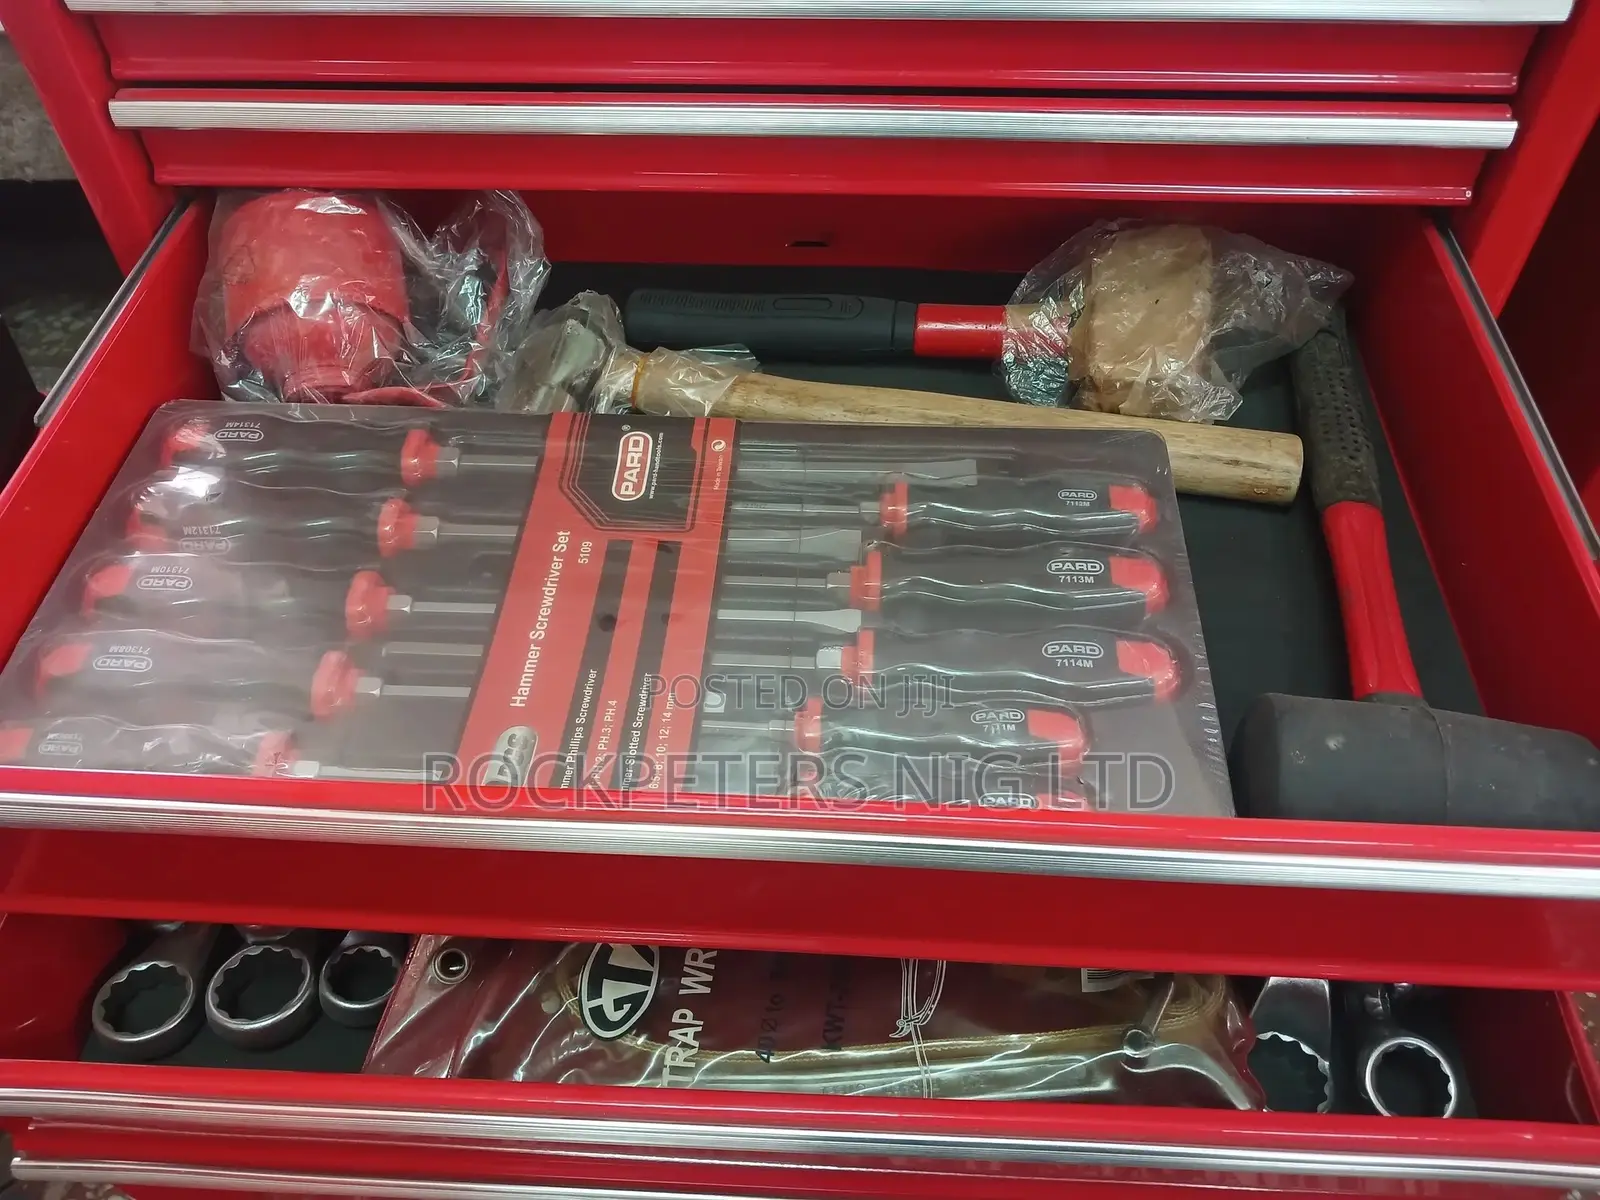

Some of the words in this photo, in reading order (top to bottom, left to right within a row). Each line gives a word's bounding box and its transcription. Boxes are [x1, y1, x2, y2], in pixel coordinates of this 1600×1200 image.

[216, 430, 260, 439] PARD
[620, 435, 645, 495] PARD
[649, 432, 664, 500] www.pard-handtools.com
[1060, 490, 1096, 499] PARD
[578, 541, 593, 564] 5109
[1050, 562, 1101, 572] PARD
[140, 578, 189, 588] PARD
[1059, 575, 1095, 584] 7113M
[510, 644, 541, 707] Hammer
[529, 556, 564, 640] Screwdriver
[552, 530, 571, 552] Set
[1046, 644, 1100, 655] PARD
[96, 658, 149, 669] PARD
[1055, 658, 1094, 668] 7114M
[632, 672, 652, 728] Screwdriver
[665, 692, 676, 710] mm
[566, 726, 584, 764] Phillips
[575, 668, 598, 724] Screwdriver
[603, 699, 618, 723] PH.4
[661, 711, 673, 723] 14
[624, 730, 641, 766] Slotted
[677, 947, 718, 995] WR
[661, 1007, 704, 1088] TRAP
